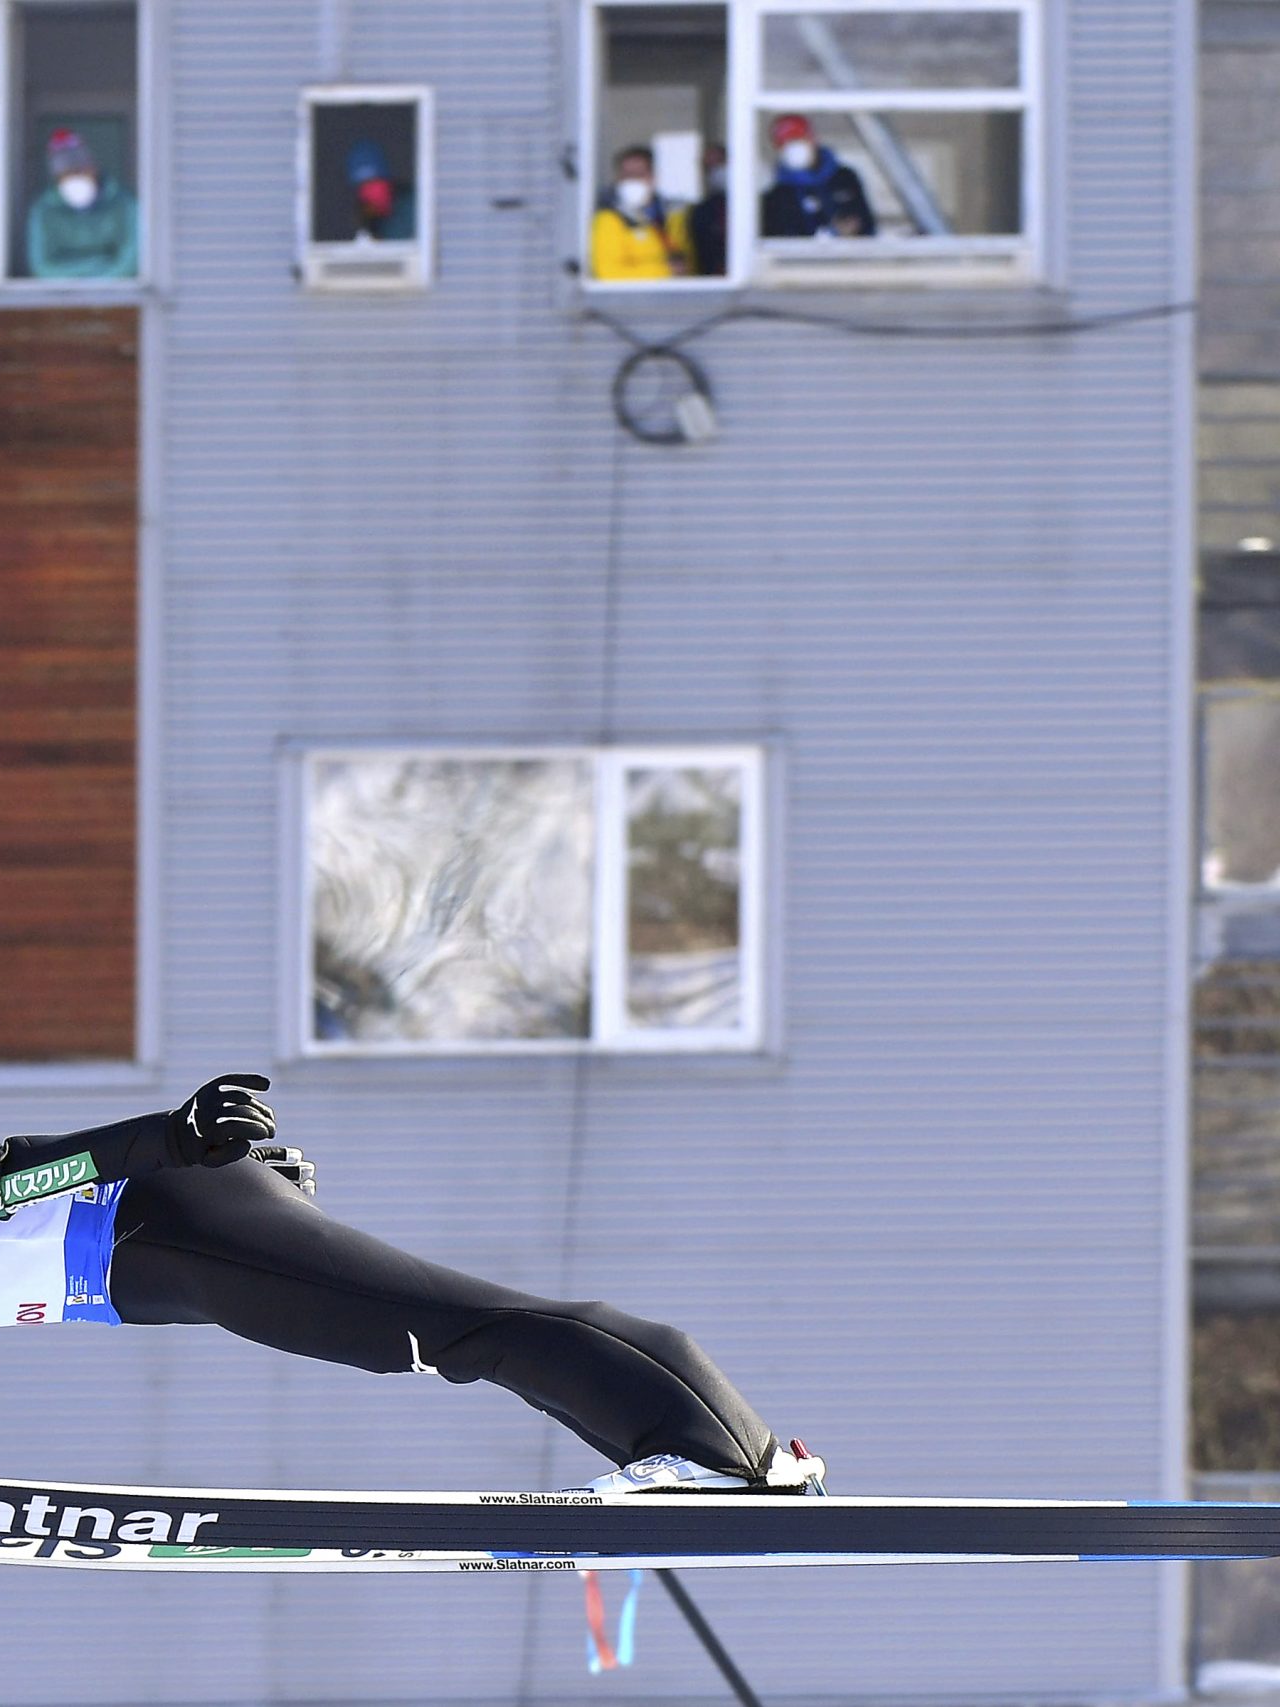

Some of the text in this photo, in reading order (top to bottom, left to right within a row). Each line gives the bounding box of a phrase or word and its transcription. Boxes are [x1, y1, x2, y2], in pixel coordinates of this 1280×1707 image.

[4, 1159, 87, 1202] バスクリン
[478, 1493, 603, 1505] www.Slatnar.com
[459, 1559, 576, 1570] www.Slatnar.com
